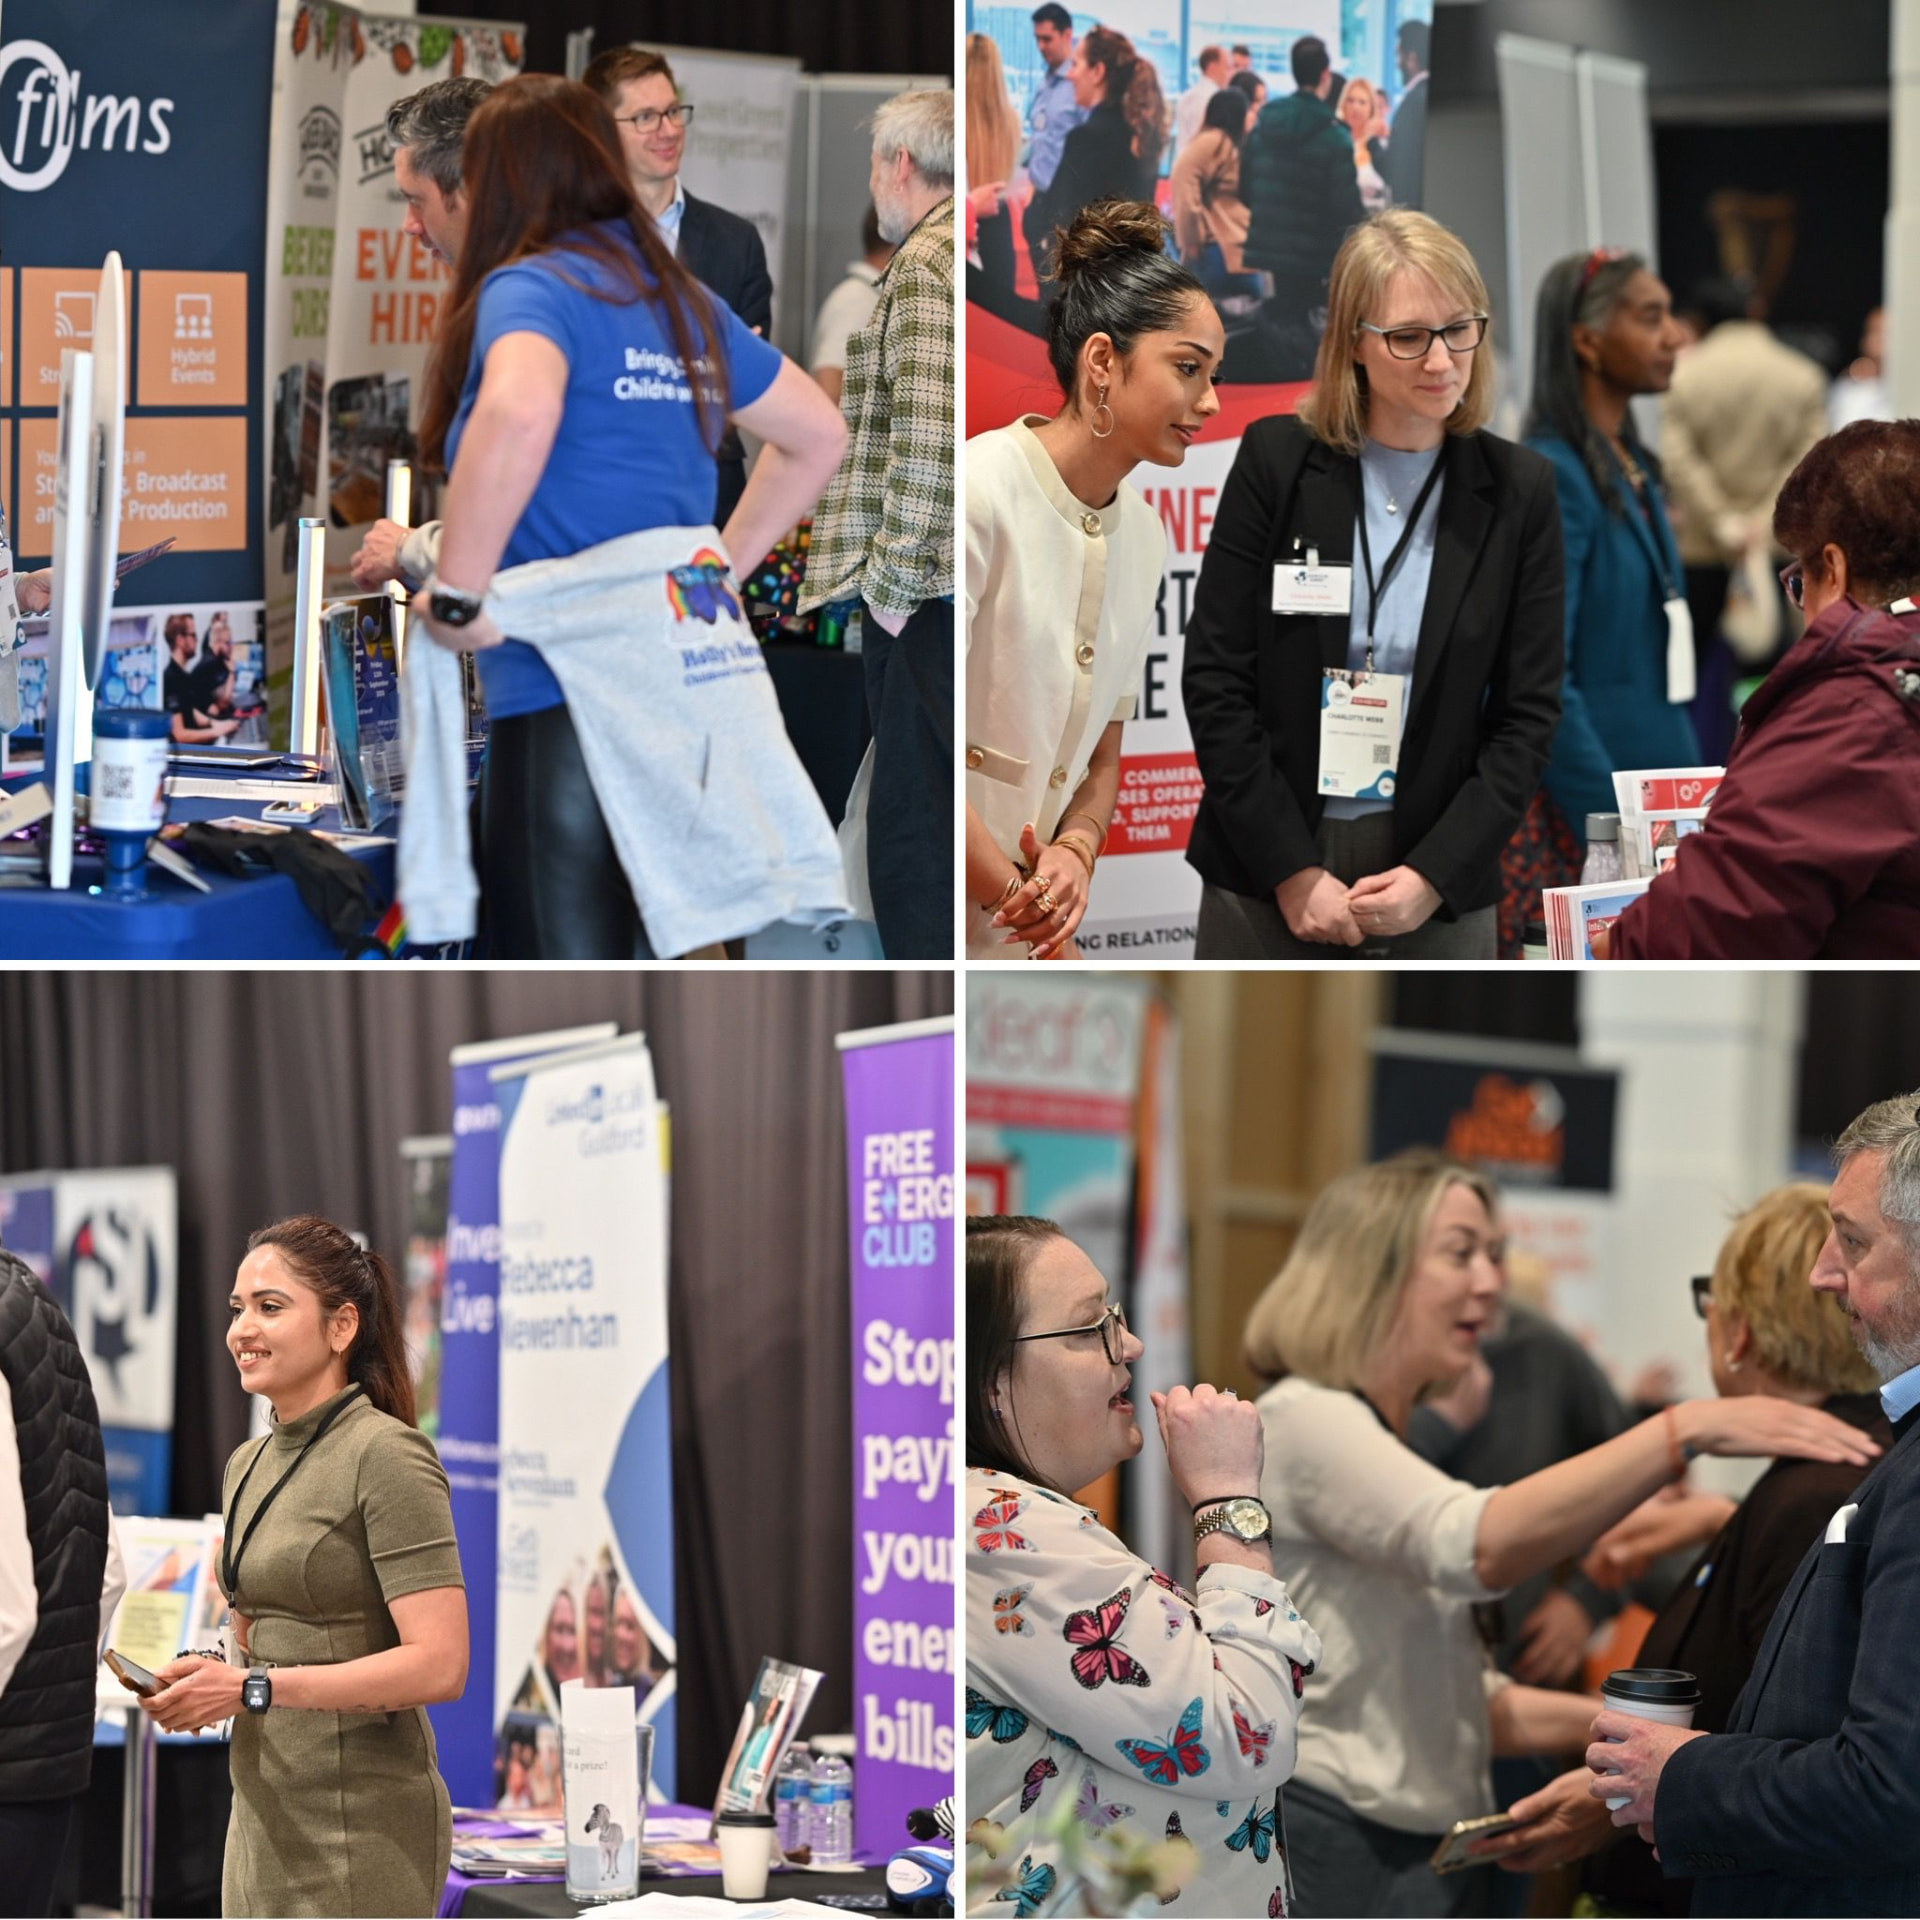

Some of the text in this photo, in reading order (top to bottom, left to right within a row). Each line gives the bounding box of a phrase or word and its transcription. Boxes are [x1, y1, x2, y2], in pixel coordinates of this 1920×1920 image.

[171, 367, 216, 384] Events
[136, 470, 228, 493] Broadcast
[128, 499, 228, 521] Production
[1126, 824, 1171, 842] THEM
[864, 1129, 935, 1178] FREE
[863, 1222, 936, 1267] CLUB
[863, 1694, 954, 1773] bills
